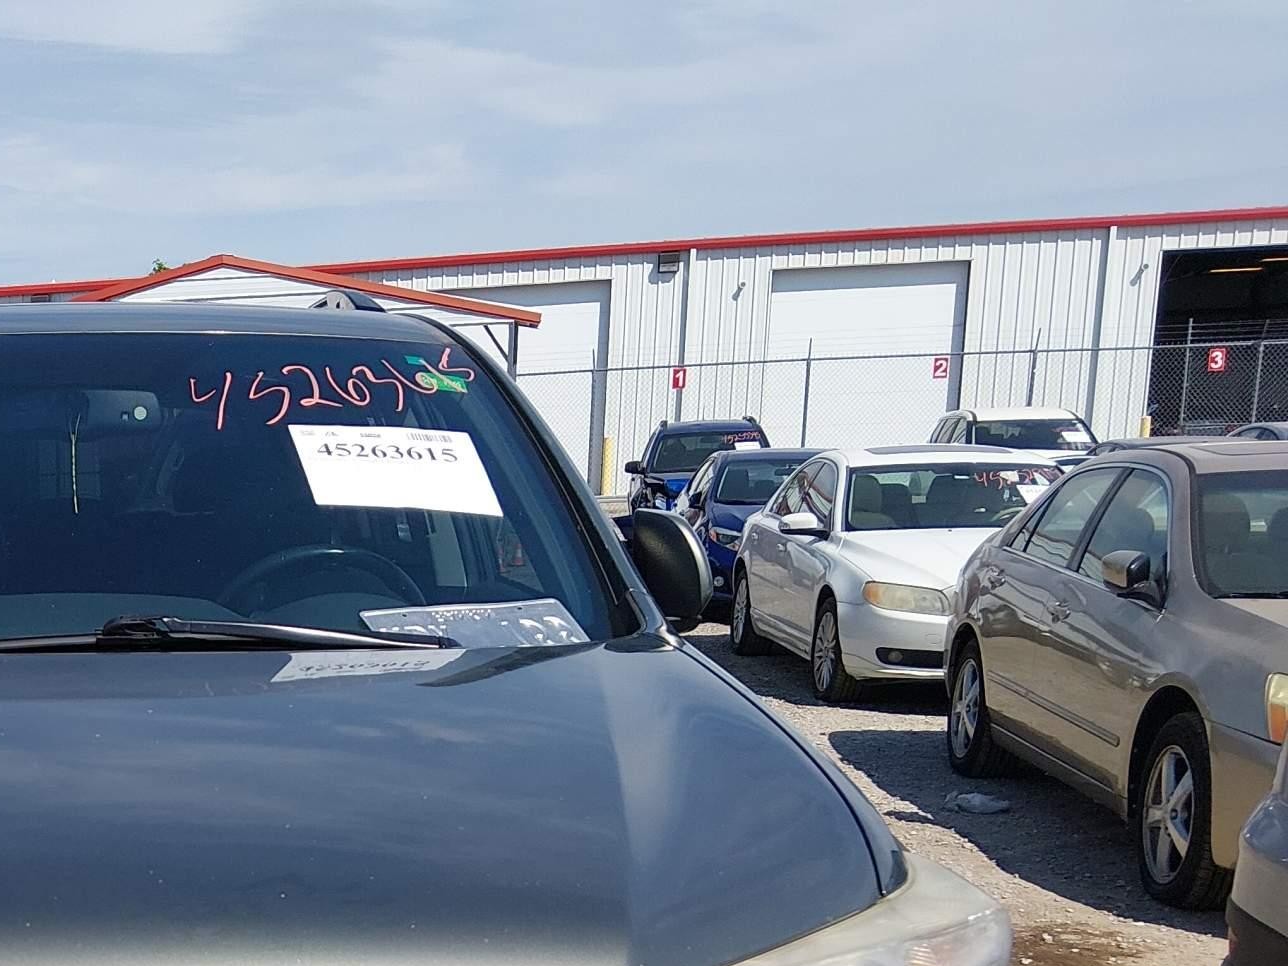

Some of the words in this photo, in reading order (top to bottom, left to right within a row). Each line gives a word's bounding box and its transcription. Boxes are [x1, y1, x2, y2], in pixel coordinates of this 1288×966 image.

[934, 360, 947, 377] 2
[1210, 351, 1223, 369] 3
[675, 370, 684, 387] 1
[316, 443, 459, 462] 45263615
